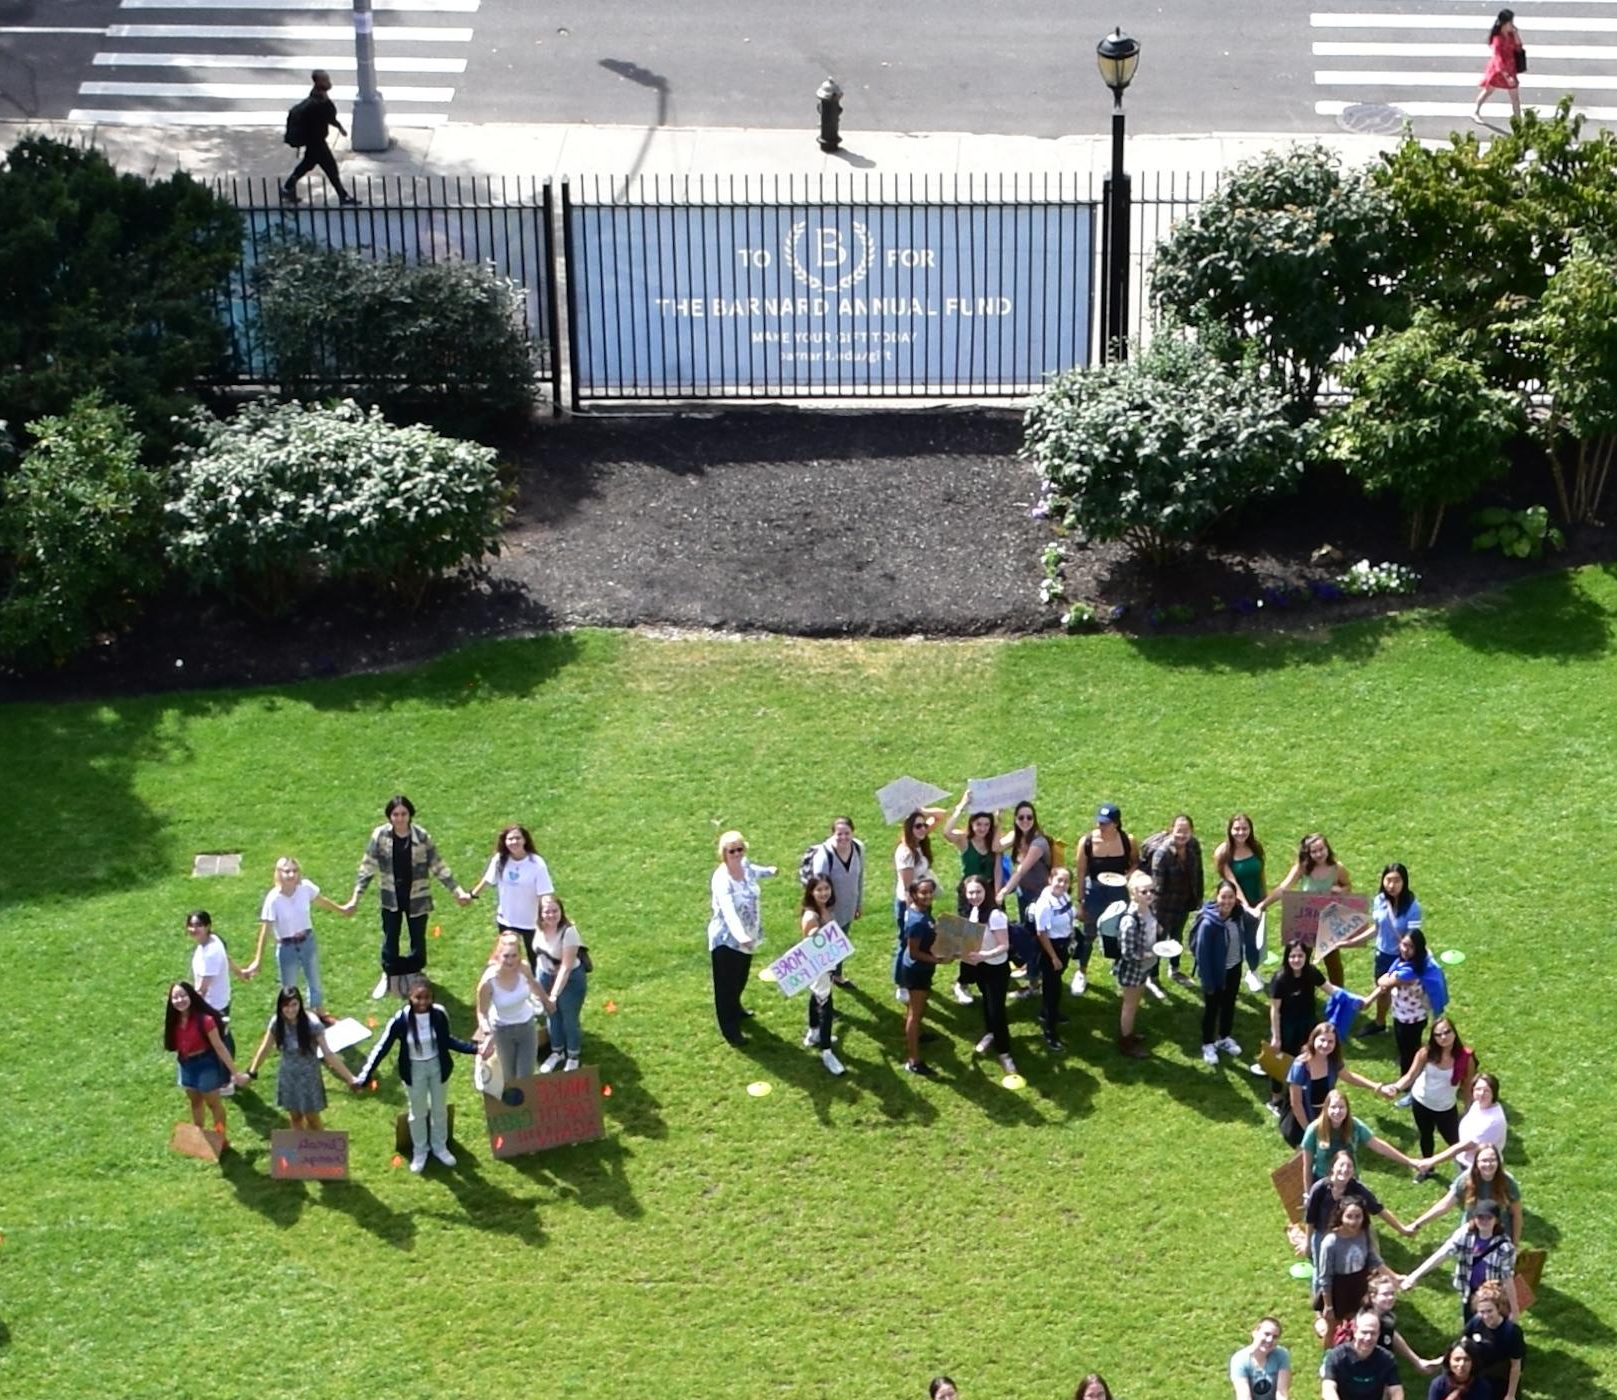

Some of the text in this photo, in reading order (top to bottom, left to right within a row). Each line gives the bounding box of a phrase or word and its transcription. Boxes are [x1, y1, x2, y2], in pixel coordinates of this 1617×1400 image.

[737, 227, 936, 268] TO B FOR
[655, 297, 1012, 317] THE BARNARD ANNUAL FUND
[794, 331, 831, 343] YOUR
[871, 331, 918, 343] TODAY
[779, 349, 892, 364] barnard.edu/git
